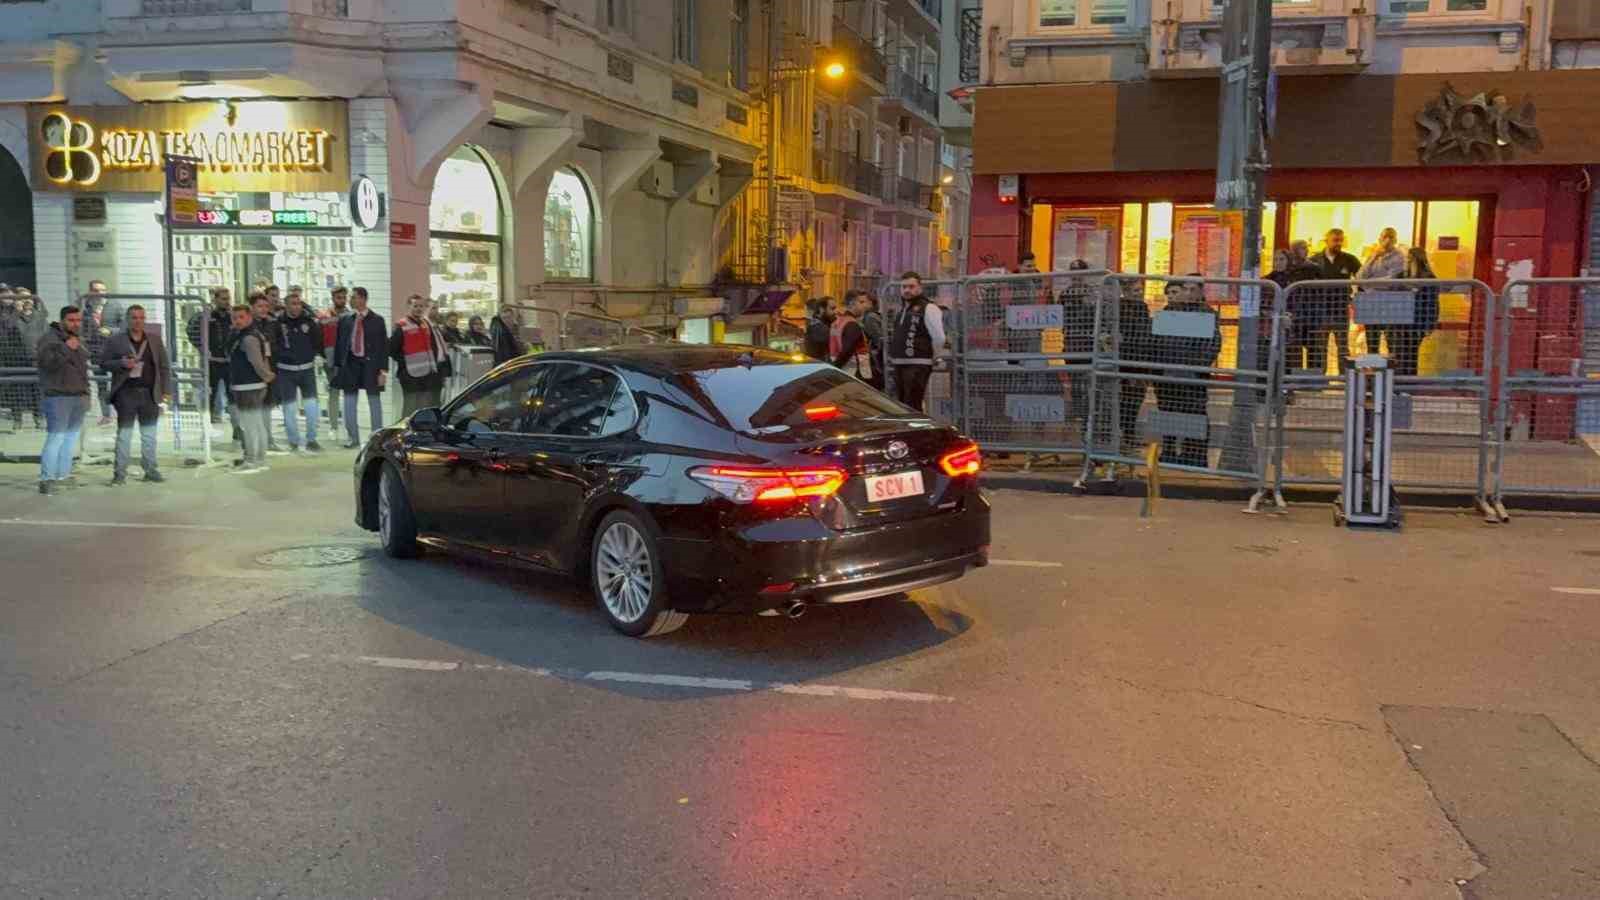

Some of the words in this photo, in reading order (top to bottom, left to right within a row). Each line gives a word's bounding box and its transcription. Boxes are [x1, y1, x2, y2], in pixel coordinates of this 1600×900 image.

[101, 130, 160, 167] KOZA
[160, 129, 328, 167] TEKNOMARKET
[874, 476, 907, 497] SCV
